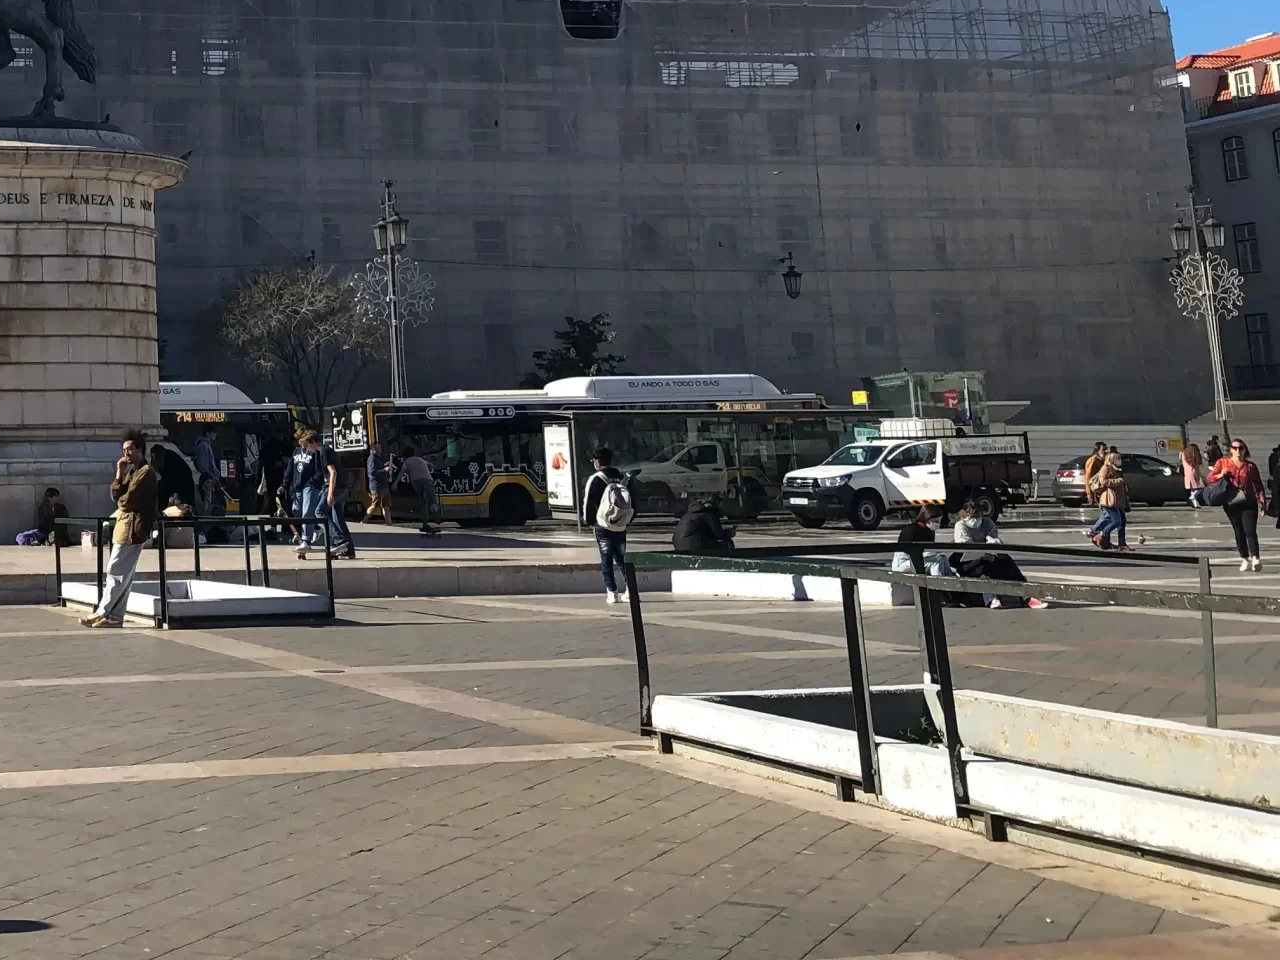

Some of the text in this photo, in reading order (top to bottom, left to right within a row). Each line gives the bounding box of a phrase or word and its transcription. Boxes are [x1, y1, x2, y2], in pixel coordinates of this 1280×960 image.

[40, 192, 48, 205] E
[57, 193, 115, 207] FIRMEZA
[123, 196, 135, 209] DE
[175, 412, 193, 423] 714
